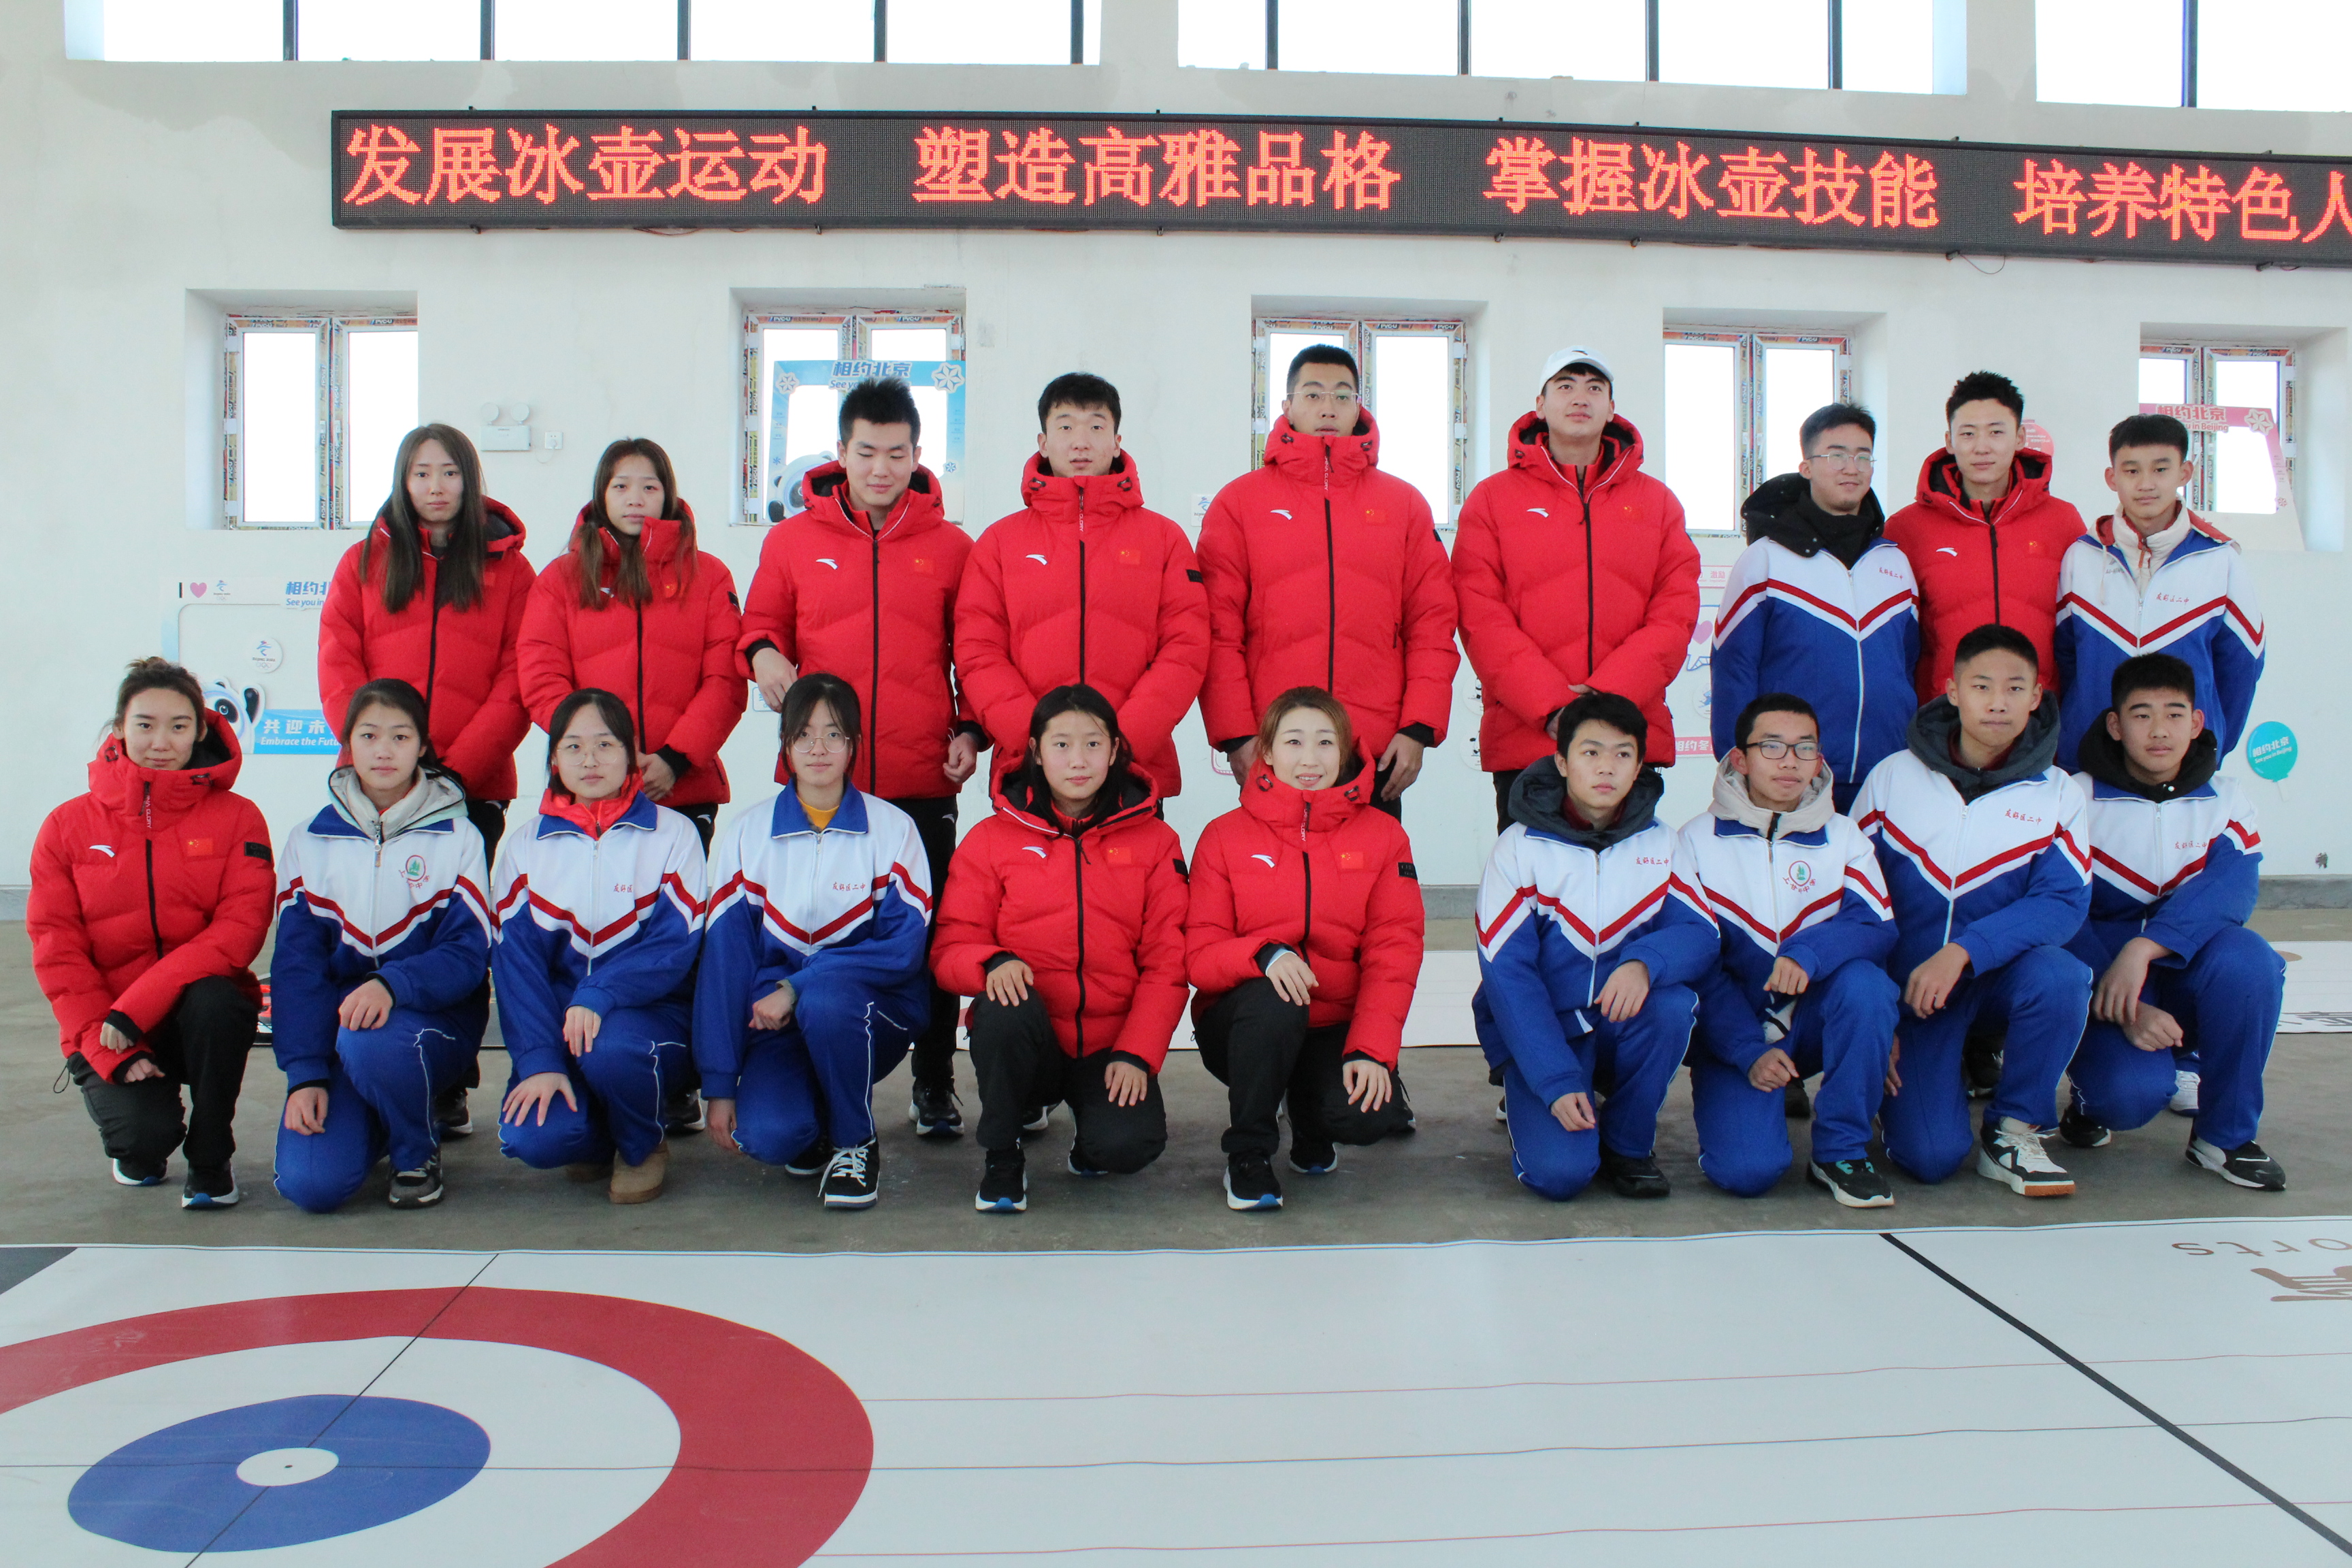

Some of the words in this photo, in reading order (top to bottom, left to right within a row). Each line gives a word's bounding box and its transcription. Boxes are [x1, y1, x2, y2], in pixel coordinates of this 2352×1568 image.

[343, 125, 828, 206] 发展冰壶运动
[911, 126, 1402, 211] 塑造高雅品格
[1483, 136, 1940, 229] 掌握冰壶技能
[2013, 159, 2352, 244] 培养特色人
[833, 361, 911, 377] 相约北京
[830, 380, 847, 389] See
[849, 381, 858, 390] yo
[2157, 406, 2225, 421] 相约北京
[2202, 423, 2228, 432] Beijing
[301, 600, 316, 608] you
[263, 719, 333, 734] 共迎未
[261, 737, 300, 745] Embrace
[1675, 740, 1712, 752] 相约冬
[2253, 736, 2289, 757] 相约北京
